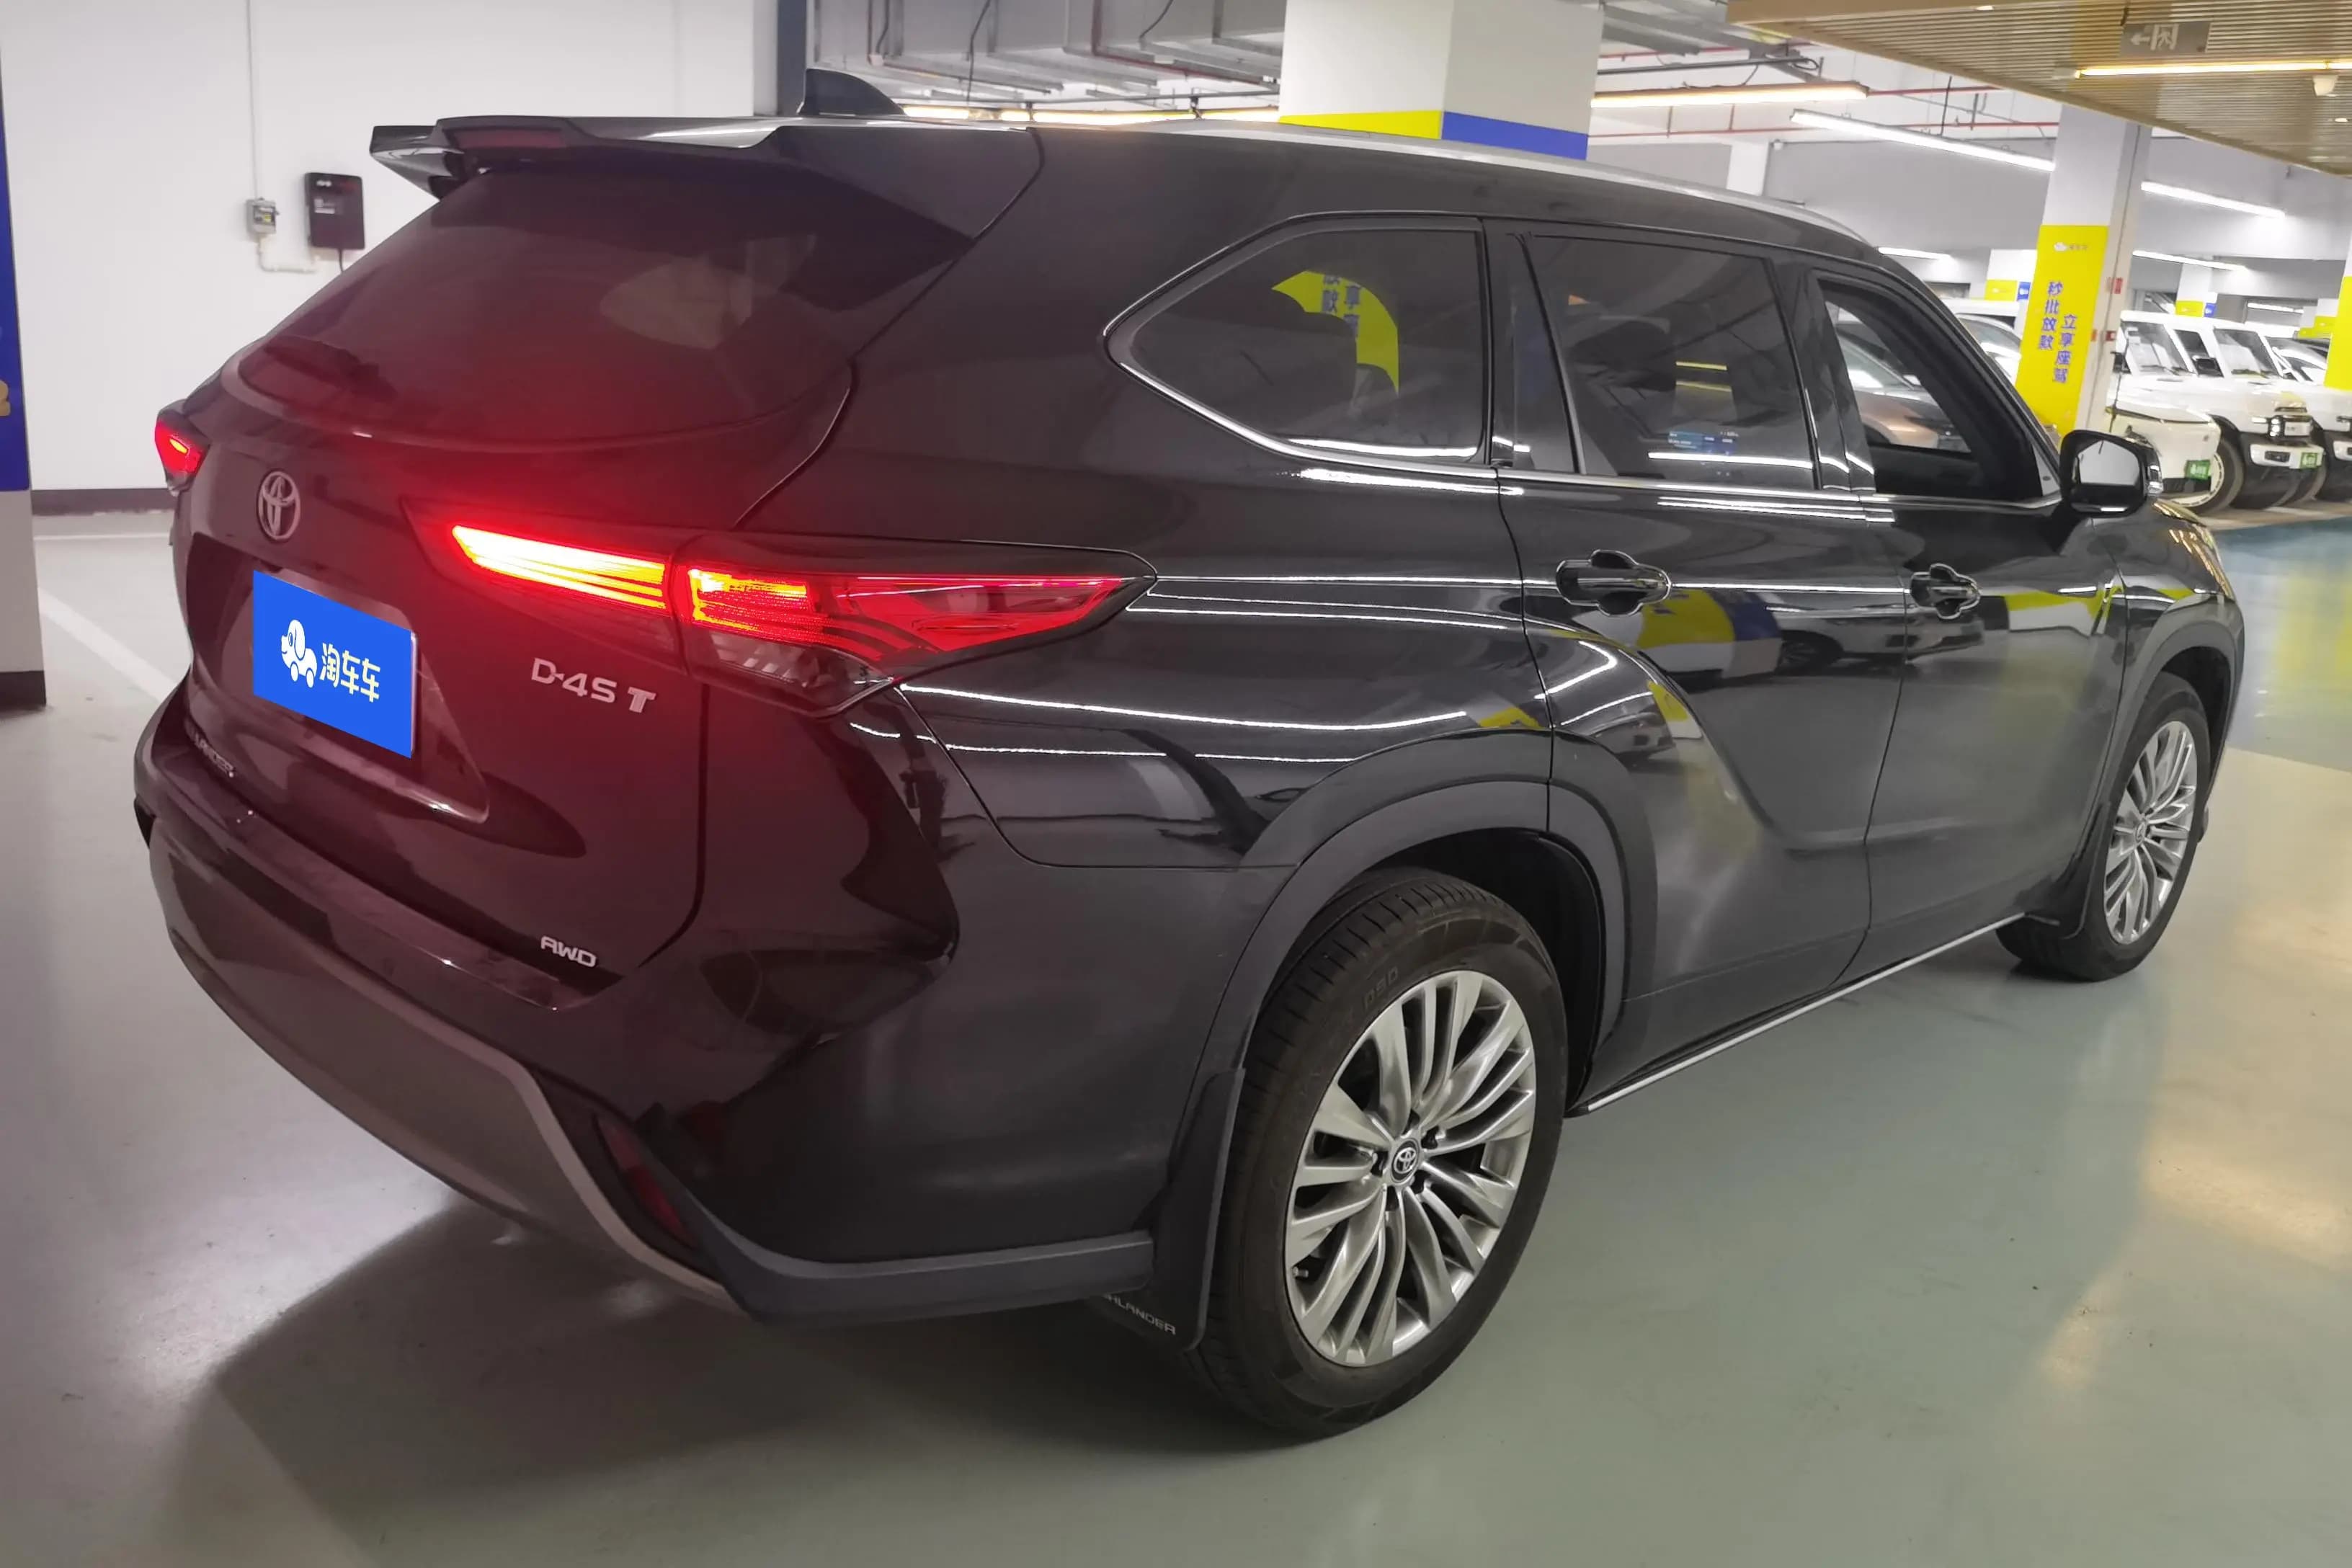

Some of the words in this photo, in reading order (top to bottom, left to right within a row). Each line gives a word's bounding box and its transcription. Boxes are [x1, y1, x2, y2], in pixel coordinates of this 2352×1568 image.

[2038, 280, 2063, 350] 秒批放款
[531, 657, 618, 703] D-4S
[627, 686, 657, 713] T
[540, 935, 597, 968] AWD
